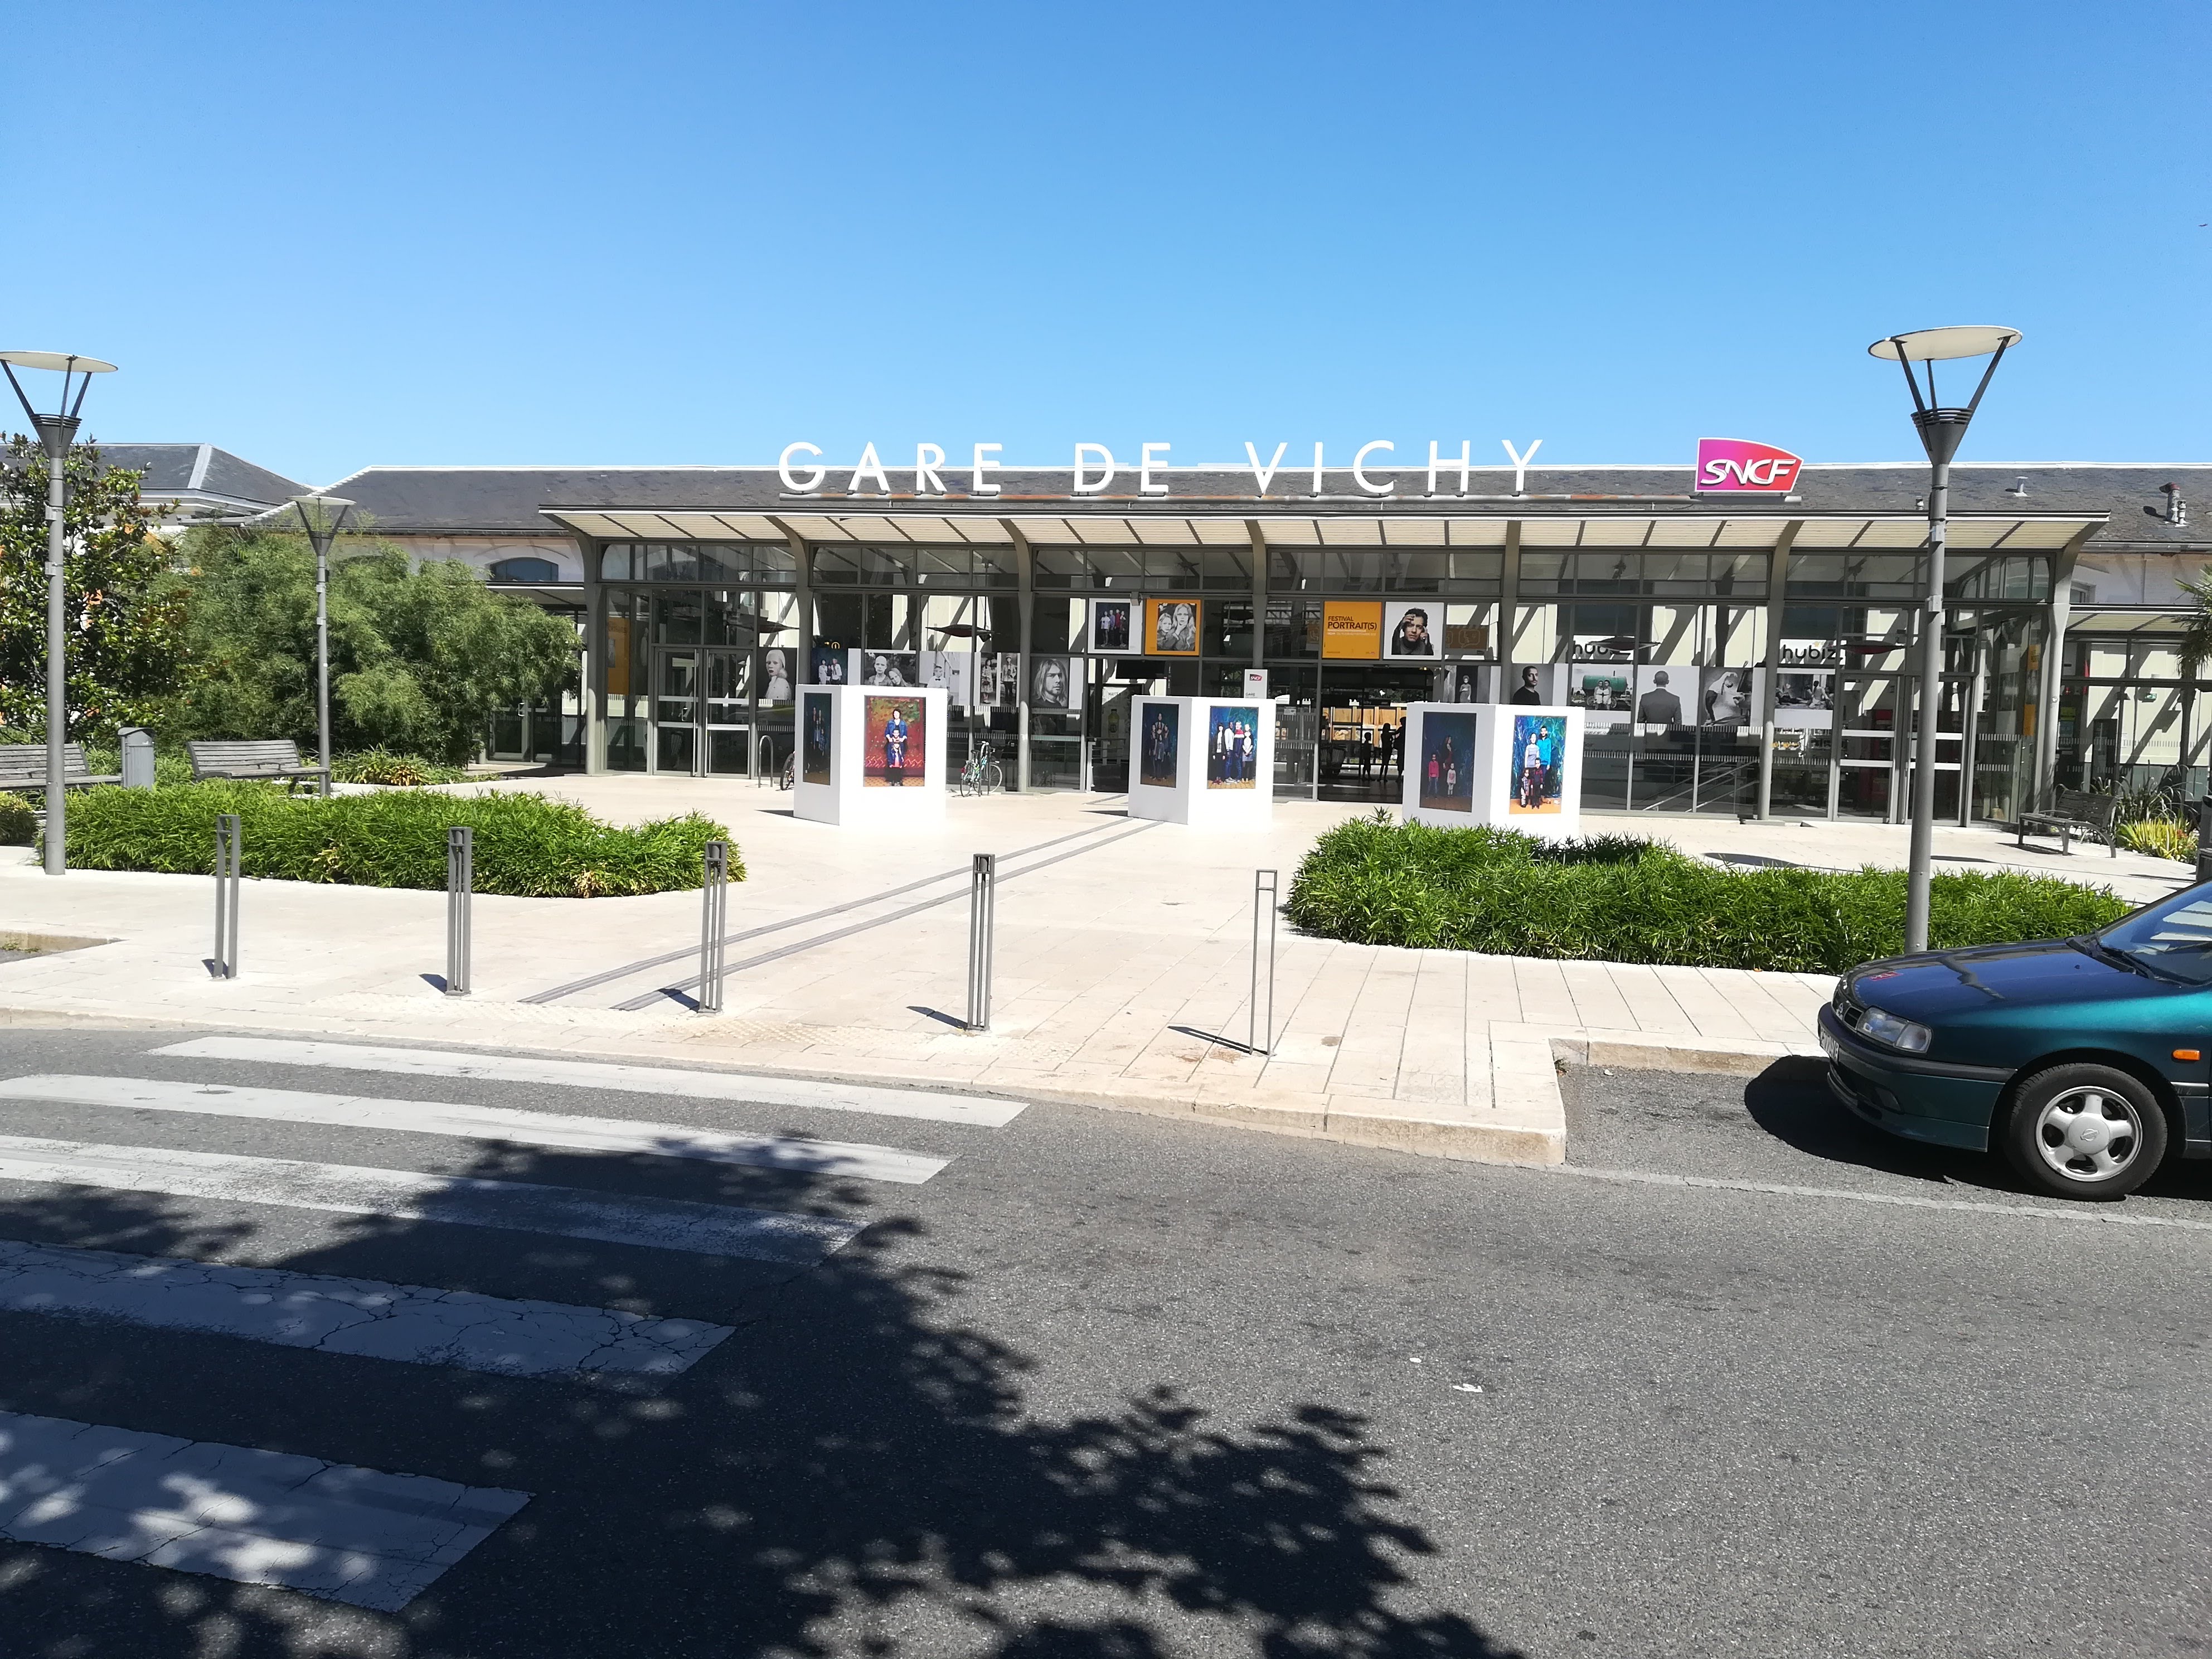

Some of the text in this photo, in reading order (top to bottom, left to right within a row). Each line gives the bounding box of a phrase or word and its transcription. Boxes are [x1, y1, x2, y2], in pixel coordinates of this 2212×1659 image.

[778, 439, 1542, 494] GARE DE VICHY
[1700, 459, 1797, 485] SNCF
[1327, 622, 1377, 630] PORTRAIT(S)
